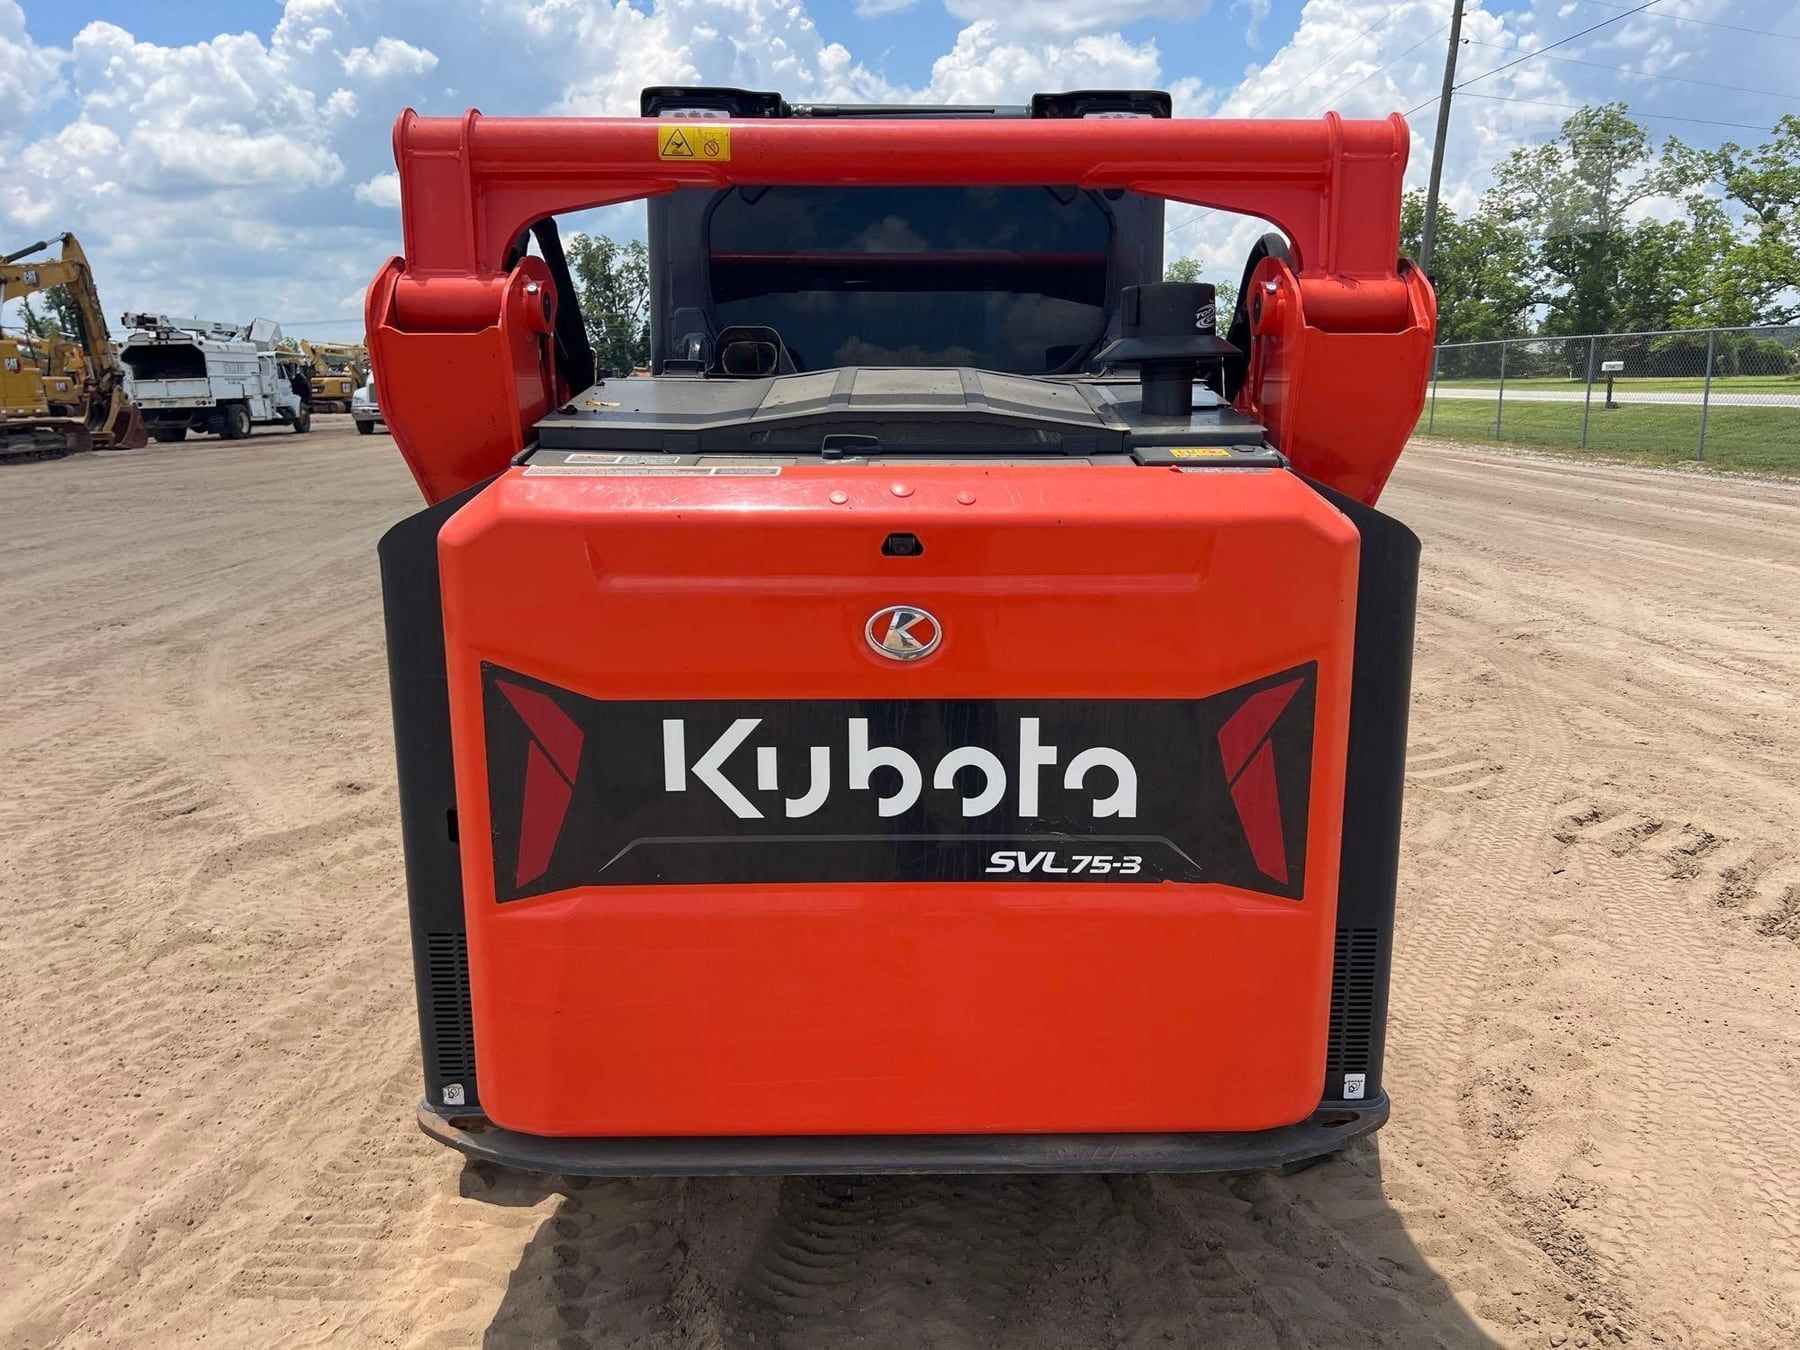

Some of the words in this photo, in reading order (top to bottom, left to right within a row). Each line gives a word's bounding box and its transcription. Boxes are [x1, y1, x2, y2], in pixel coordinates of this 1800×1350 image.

[23, 270, 37, 284] CAT
[5, 357, 18, 370] CAT
[662, 717, 1138, 818] Kubota
